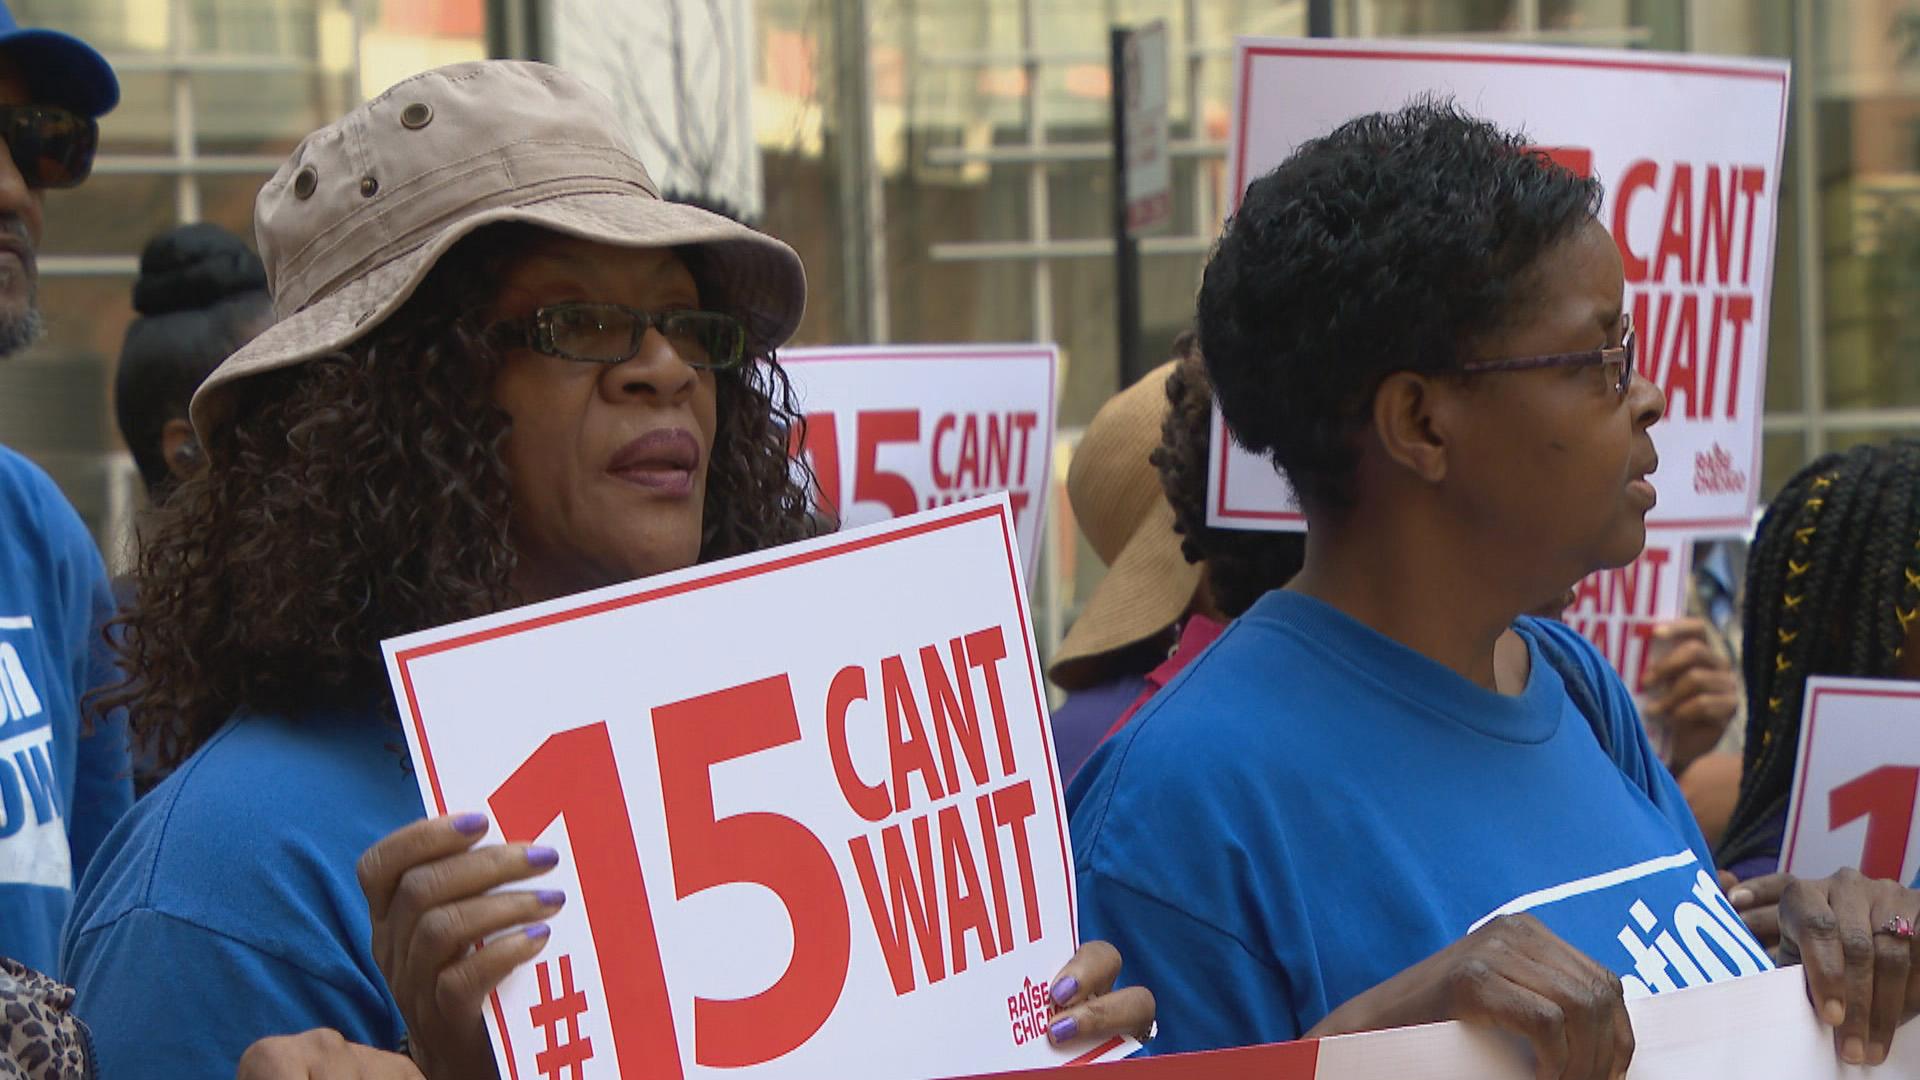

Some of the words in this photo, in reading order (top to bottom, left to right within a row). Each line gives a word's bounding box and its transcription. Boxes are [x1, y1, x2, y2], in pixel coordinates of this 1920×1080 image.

[1612, 158, 1765, 285] CANT
[930, 411, 1037, 490] CANT
[826, 625, 1007, 822] CANT
[848, 779, 1043, 997] WAIT
[1007, 976, 1051, 1021] RAISE
